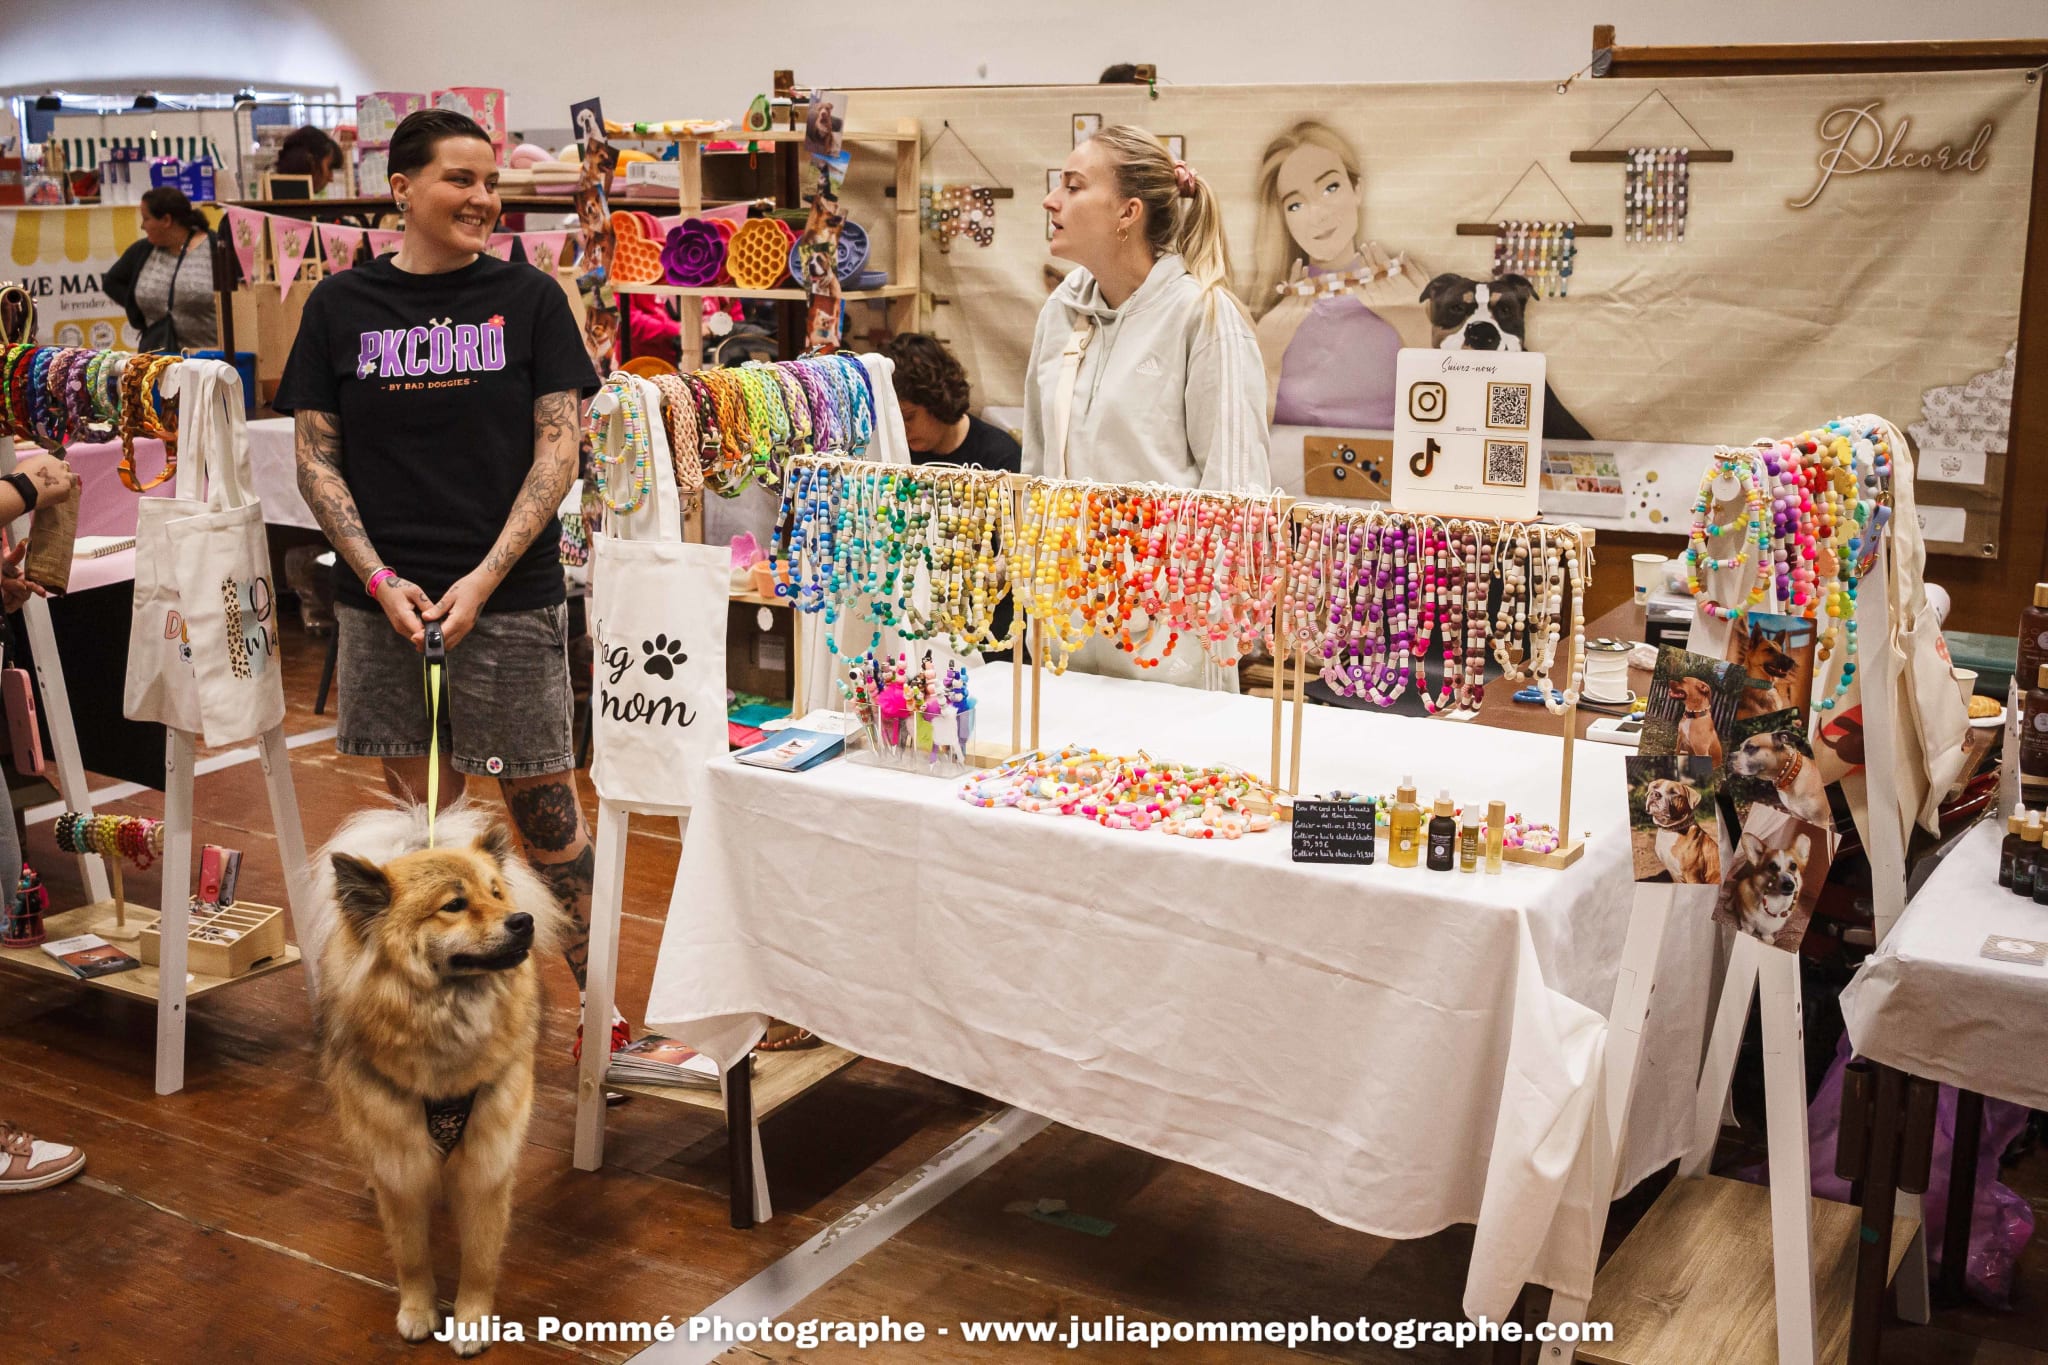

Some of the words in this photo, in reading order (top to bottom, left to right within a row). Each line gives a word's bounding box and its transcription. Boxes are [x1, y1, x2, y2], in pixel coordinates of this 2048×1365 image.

[1790, 102, 1992, 208] Pkcord
[60, 273, 105, 294] MA
[357, 323, 506, 380] PKCORD
[1441, 356, 1498, 374] Suivez-nous
[405, 382, 424, 390] BAD
[428, 378, 470, 389] DOGGIES
